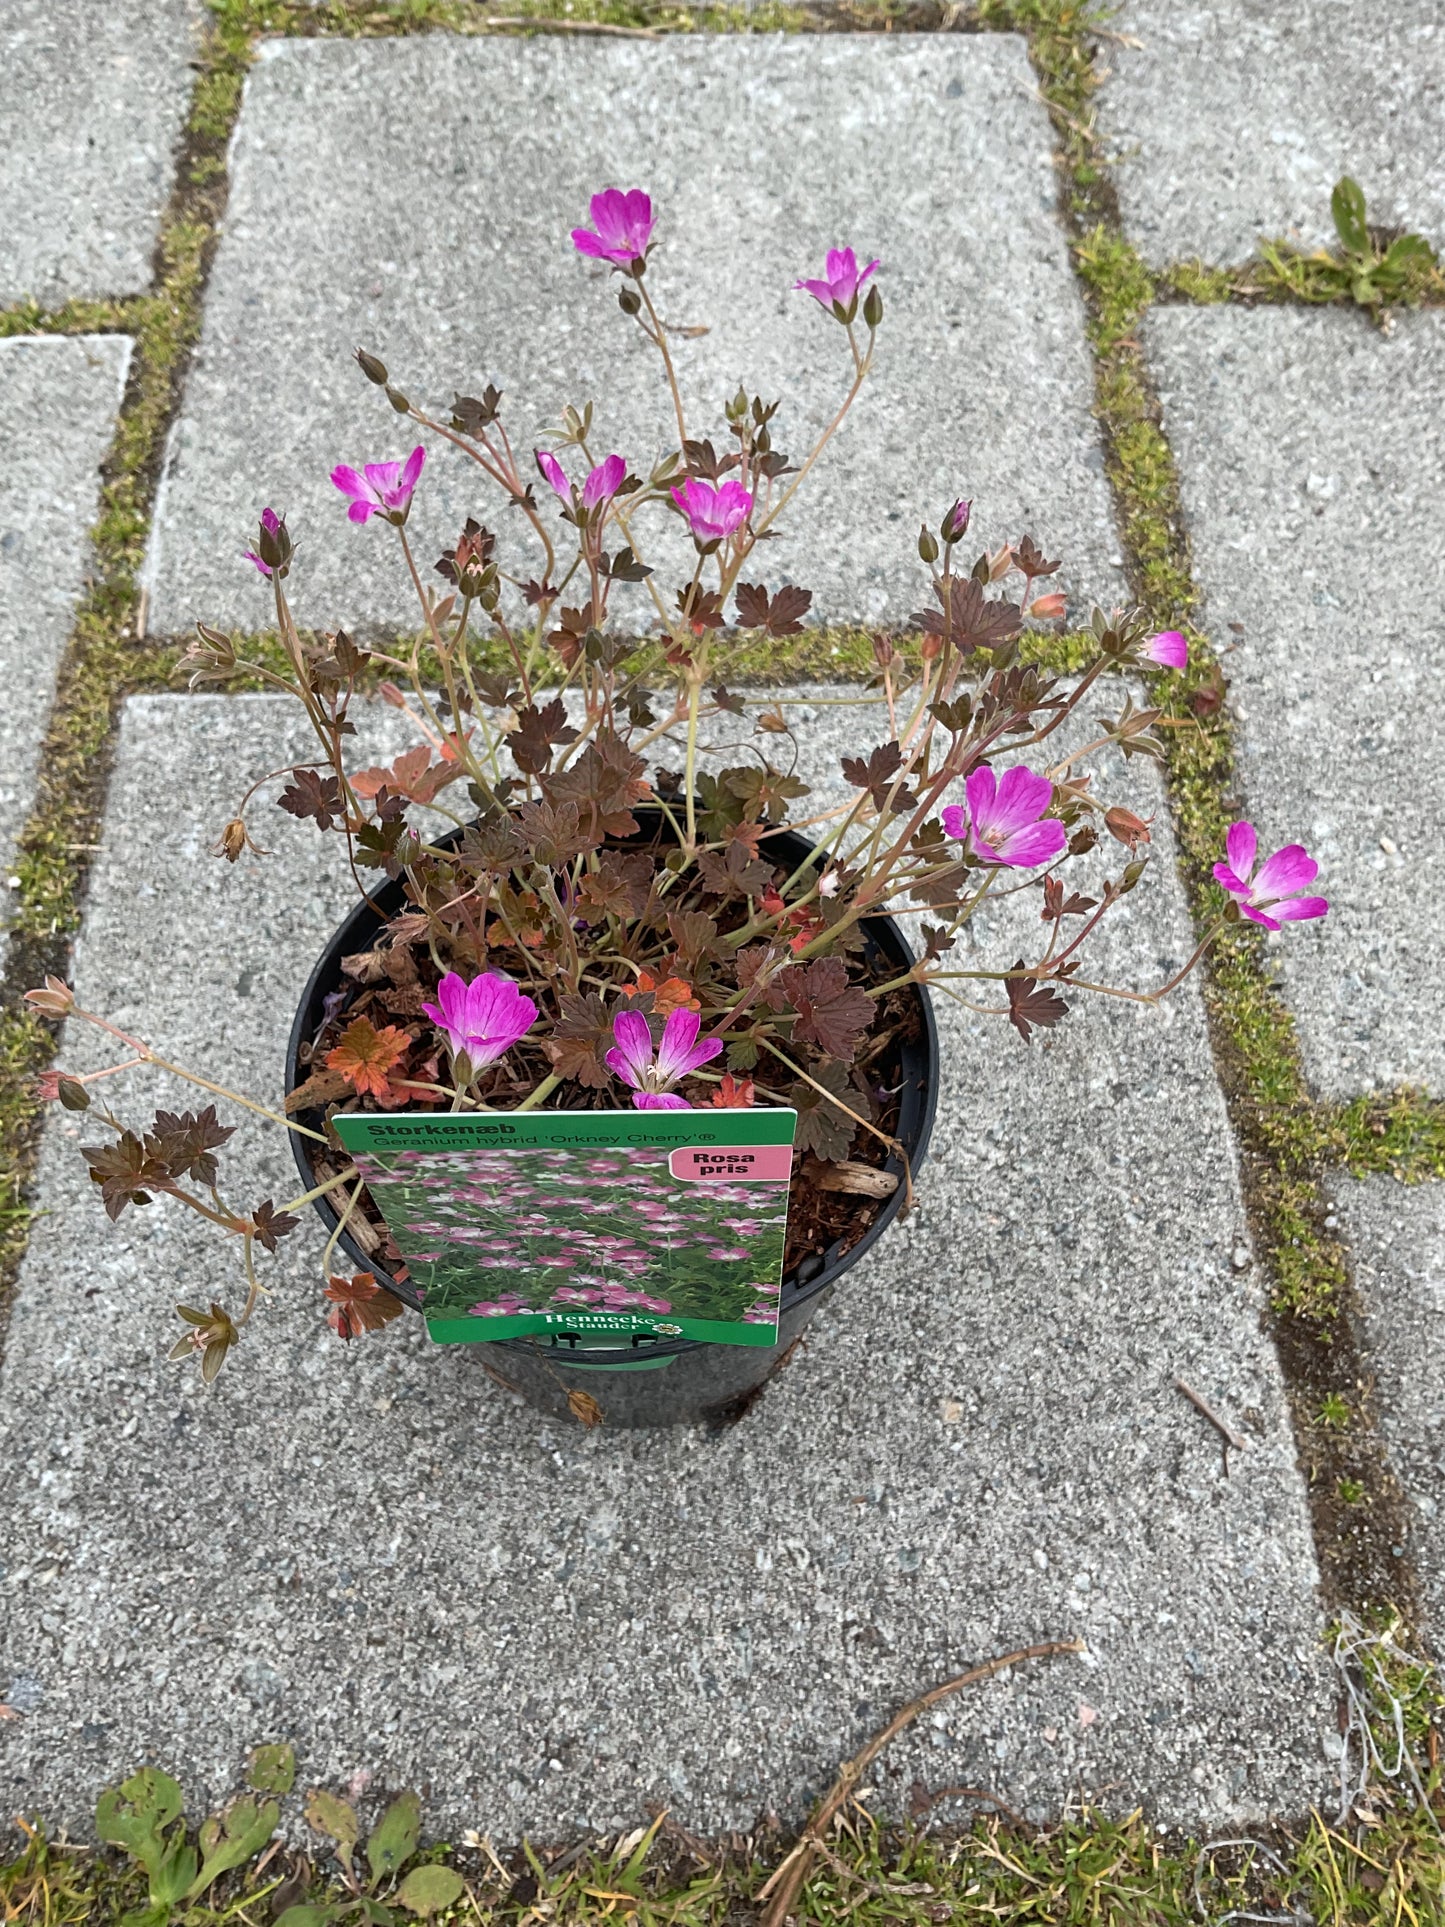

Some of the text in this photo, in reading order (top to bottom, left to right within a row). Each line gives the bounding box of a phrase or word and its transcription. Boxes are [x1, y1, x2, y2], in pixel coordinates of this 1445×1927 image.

[367, 1123, 516, 1136] Storkenæb
[374, 1137, 470, 1146] Geranium
[476, 1135, 538, 1145] hybrid
[544, 1134, 621, 1144] 'Orkney
[693, 1153, 755, 1163] Rosa
[700, 1163, 748, 1176] pris
[545, 1314, 656, 1325] Hennecke
[566, 1322, 640, 1330] Stauder
